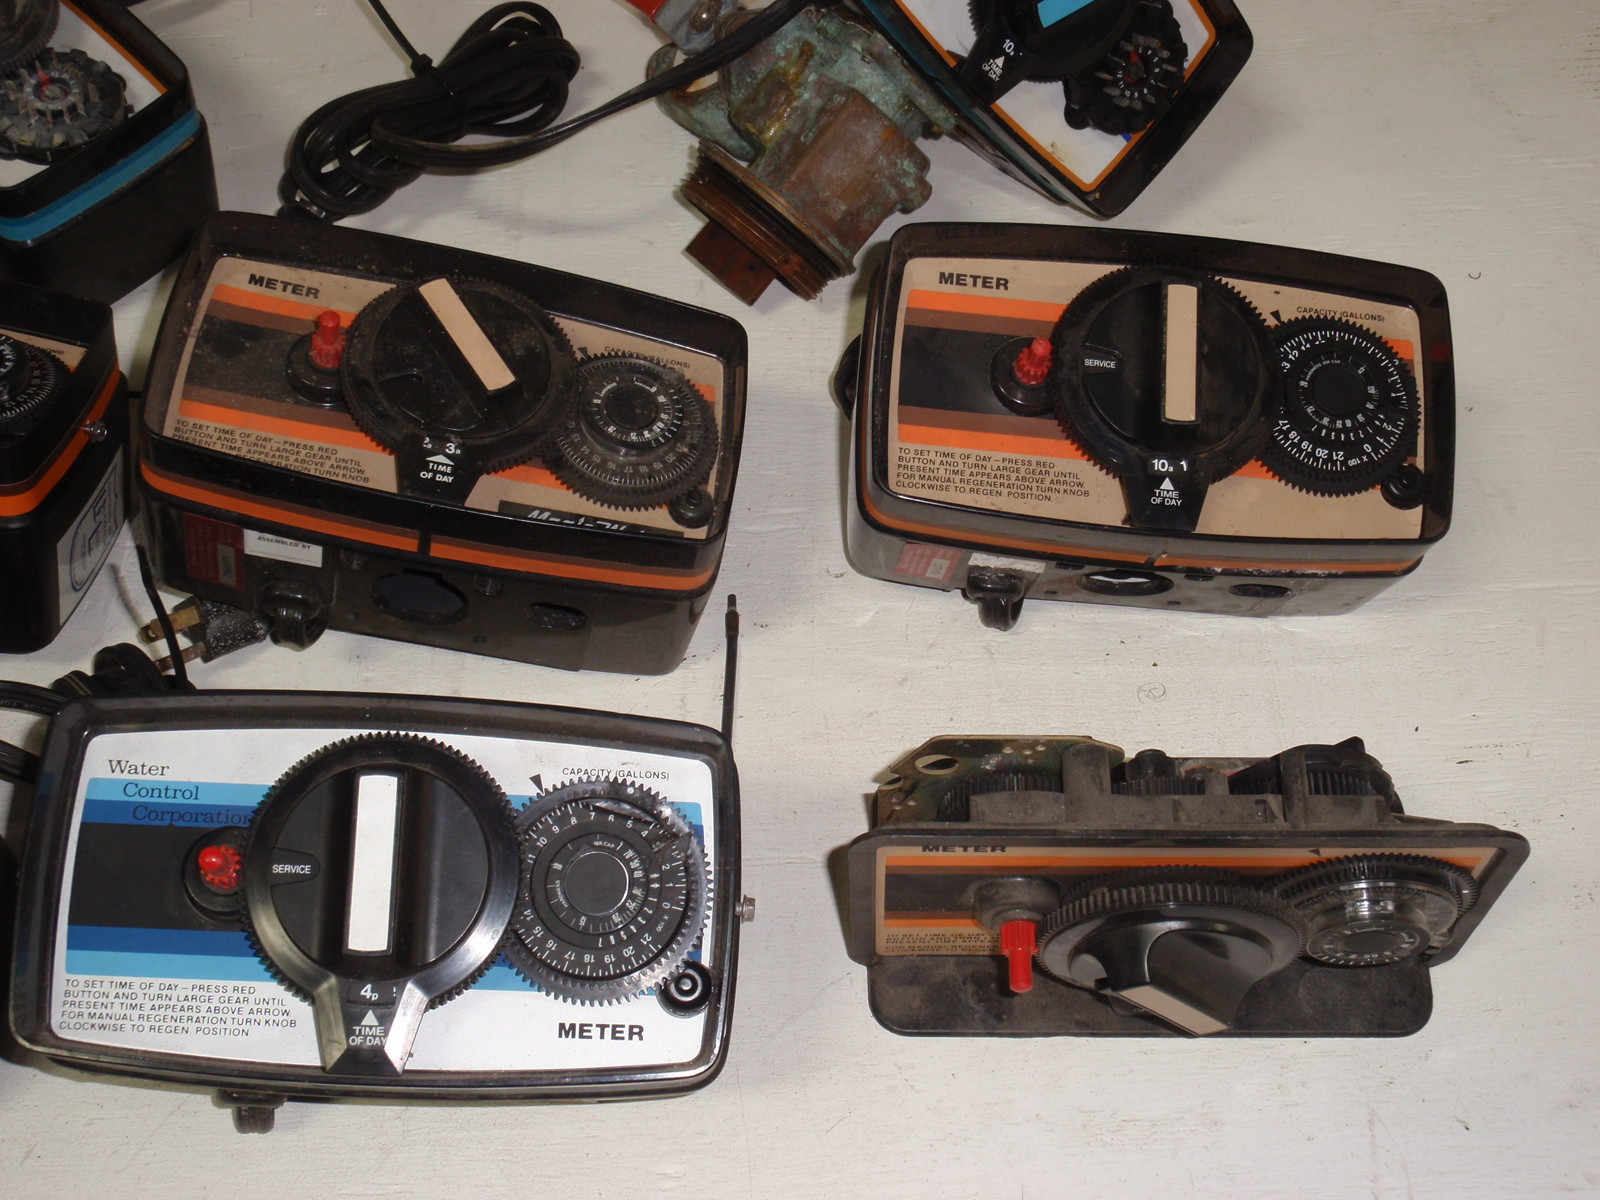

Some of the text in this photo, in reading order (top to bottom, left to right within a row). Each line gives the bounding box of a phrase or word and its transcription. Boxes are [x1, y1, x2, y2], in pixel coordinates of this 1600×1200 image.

[988, 59, 1002, 76] TIME
[249, 274, 320, 300] METER
[939, 272, 1010, 290] METER
[1296, 306, 1385, 322] CAPACITY (GALLONS)
[1084, 359, 1116, 368] SERVICE
[1278, 420, 1290, 431] 17
[192, 423, 210, 433] SET
[213, 427, 236, 437] TIME
[239, 431, 253, 440] OF
[256, 434, 274, 444] DAY
[284, 439, 315, 451] PRESS
[318, 445, 338, 456] RED
[1288, 431, 1300, 444] 18
[174, 427, 363, 467] BUTTON AND TURN LARGE GEAR UNTIL
[1301, 441, 1313, 452] 19
[221, 442, 243, 453] TIME
[247, 446, 291, 462] APPEARS
[294, 454, 326, 468] ABOVE
[899, 448, 1056, 469] TO SET TIME OF DAY PRESS RED
[1316, 448, 1328, 458] 20
[1333, 451, 1344, 461] 21
[429, 462, 452, 474] TIME
[897, 464, 940, 475] PRESENT
[944, 468, 966, 478] TIME
[969, 470, 1012, 482] APPEARS
[1015, 474, 1046, 484] ABOVE
[898, 456, 1080, 480] BUTTON AND TURN LARGE GEAR UNTIL
[314, 468, 339, 478] TURN
[342, 472, 370, 483] KNOB
[436, 474, 454, 482] DAY
[896, 481, 950, 493] CLOCKWISE
[955, 486, 966, 494] TO
[897, 472, 1090, 497] FOR MANUAL REGENERATION TURN KNOB
[1154, 489, 1180, 498] TIME
[1151, 496, 1183, 506] OF DAY
[258, 536, 298, 547] ASSEMBLED
[108, 759, 170, 776] Water
[562, 768, 669, 780] CAPACITY (GALLONS)
[123, 783, 200, 800] Control
[537, 837, 547, 846] 10
[272, 864, 311, 874] SERVICE
[532, 926, 544, 937] 15
[546, 939, 558, 950] 16
[641, 933, 652, 945] 21
[564, 951, 575, 960] 17
[623, 946, 635, 957] 20
[584, 955, 595, 963] 18
[605, 954, 616, 963] 19
[65, 979, 255, 994] TO SET TIME OF DAY PRESS RED
[360, 984, 378, 1001] 4p
[64, 990, 286, 1005] BUTTON AND TURN LARGE GEAR UNTIL
[62, 1000, 114, 1010] PRESENT
[119, 1002, 145, 1011] TIME
[150, 1003, 202, 1013] APPEARS
[206, 1005, 243, 1014] ABOVE
[61, 1011, 296, 1026] FOR MANUAL REGENERATION TURN KNOB
[59, 1021, 125, 1031] CLOCKWISE
[131, 1024, 144, 1032] TO
[353, 1026, 385, 1036] TIME
[558, 1022, 644, 1041] METER
[349, 1036, 388, 1046] OF DAY
